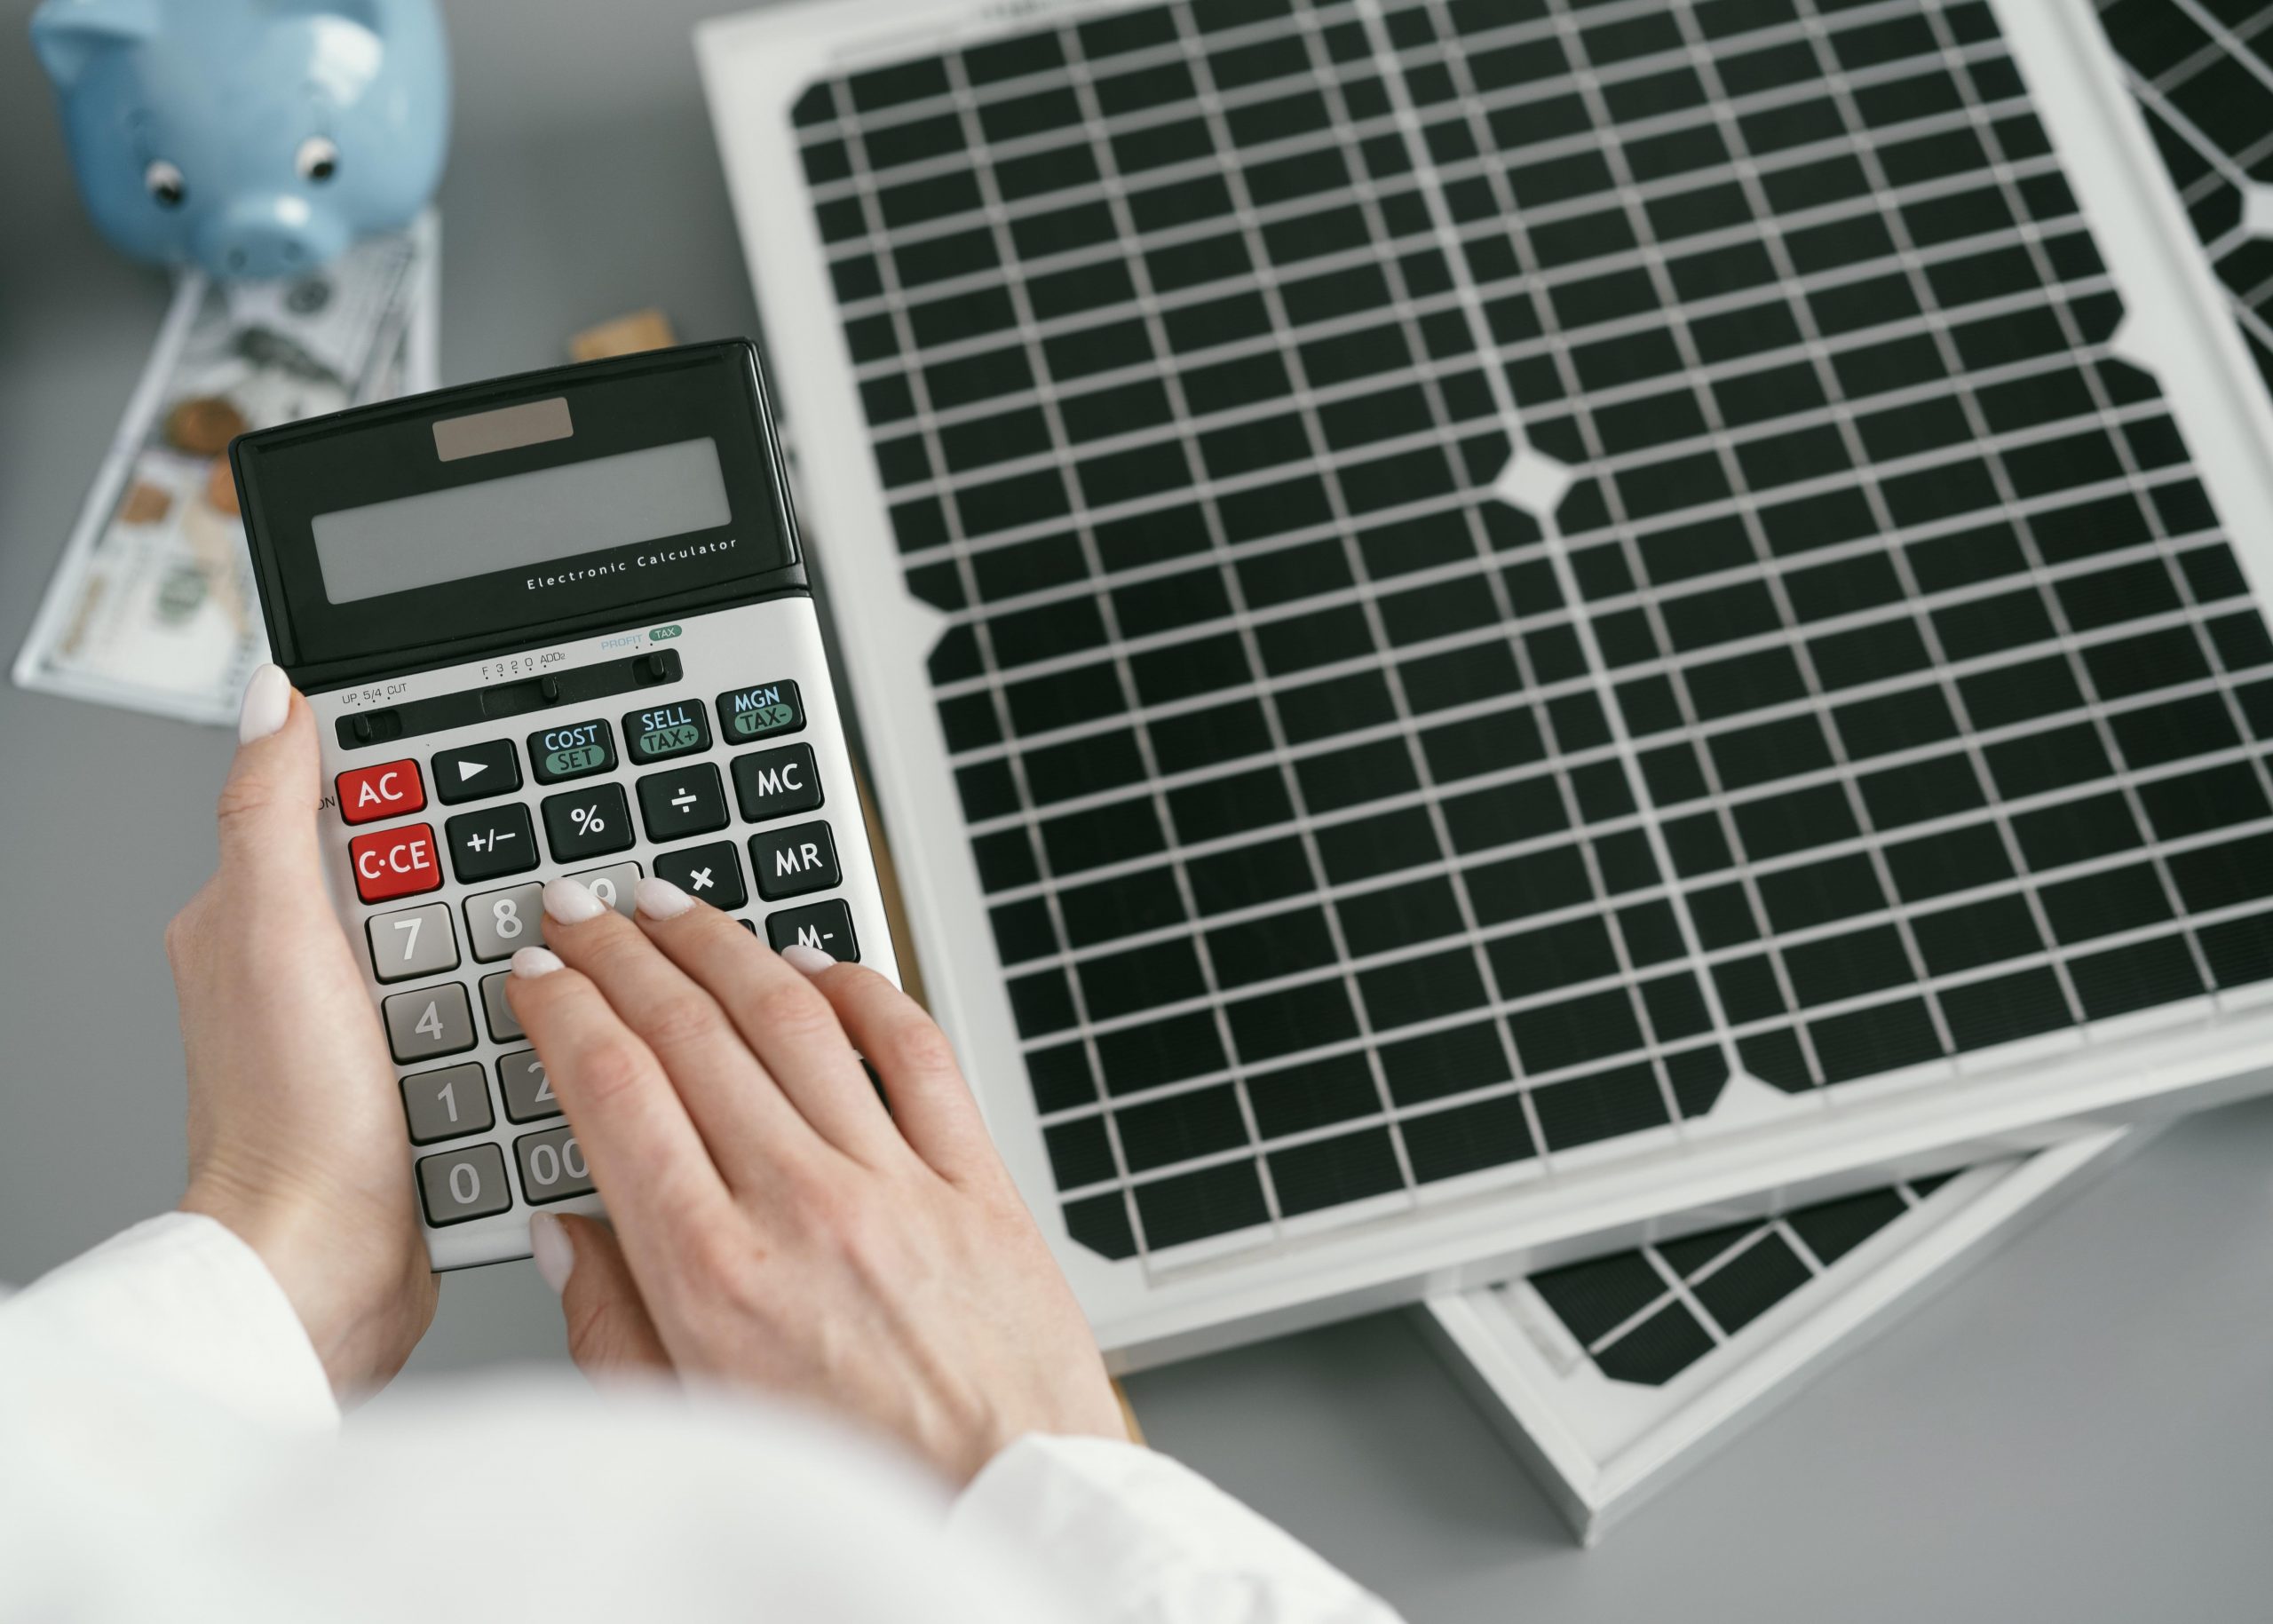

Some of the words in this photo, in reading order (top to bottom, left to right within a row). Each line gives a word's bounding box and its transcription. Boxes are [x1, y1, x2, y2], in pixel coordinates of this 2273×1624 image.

[527, 561, 626, 590] Electronic
[637, 538, 736, 566] Calculator
[600, 634, 643, 650] PROFIT
[654, 628, 676, 638] TAX
[495, 663, 504, 672] 3
[511, 661, 518, 669] 2
[342, 693, 357, 704] UP
[363, 688, 382, 700] 5/4
[387, 683, 408, 694] CUT
[735, 686, 780, 712] MGN
[641, 707, 691, 731] SELL
[545, 725, 597, 751] COST
[644, 730, 695, 754] TAX+
[558, 749, 593, 771] SET
[358, 772, 403, 807] AC
[758, 764, 803, 796] MC
[571, 804, 605, 836] %
[776, 843, 823, 876] MR
[493, 899, 523, 939] 8
[393, 917, 423, 960] 7
[414, 1001, 444, 1041] 4
[437, 1082, 458, 1122] 1
[530, 1137, 590, 1185] 00
[448, 1162, 480, 1204] 0
